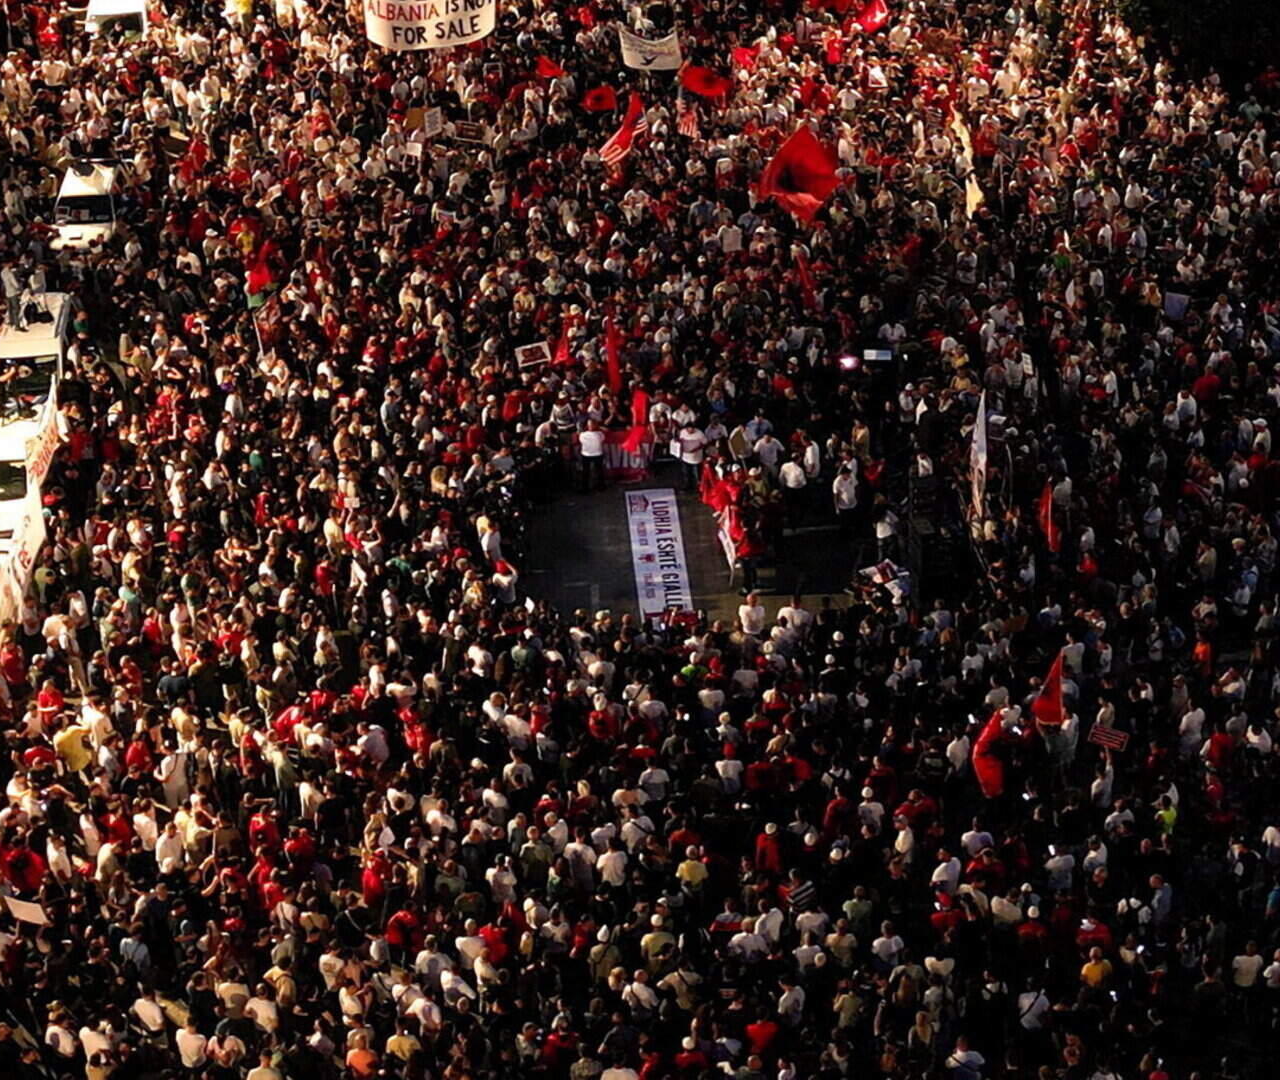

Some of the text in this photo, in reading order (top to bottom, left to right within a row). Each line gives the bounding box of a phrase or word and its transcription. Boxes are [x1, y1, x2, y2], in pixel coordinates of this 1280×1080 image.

[392, 14, 481, 45] FOR SALE
[651, 500, 672, 535] LIDHJA
[656, 537, 682, 570] ËSHTË
